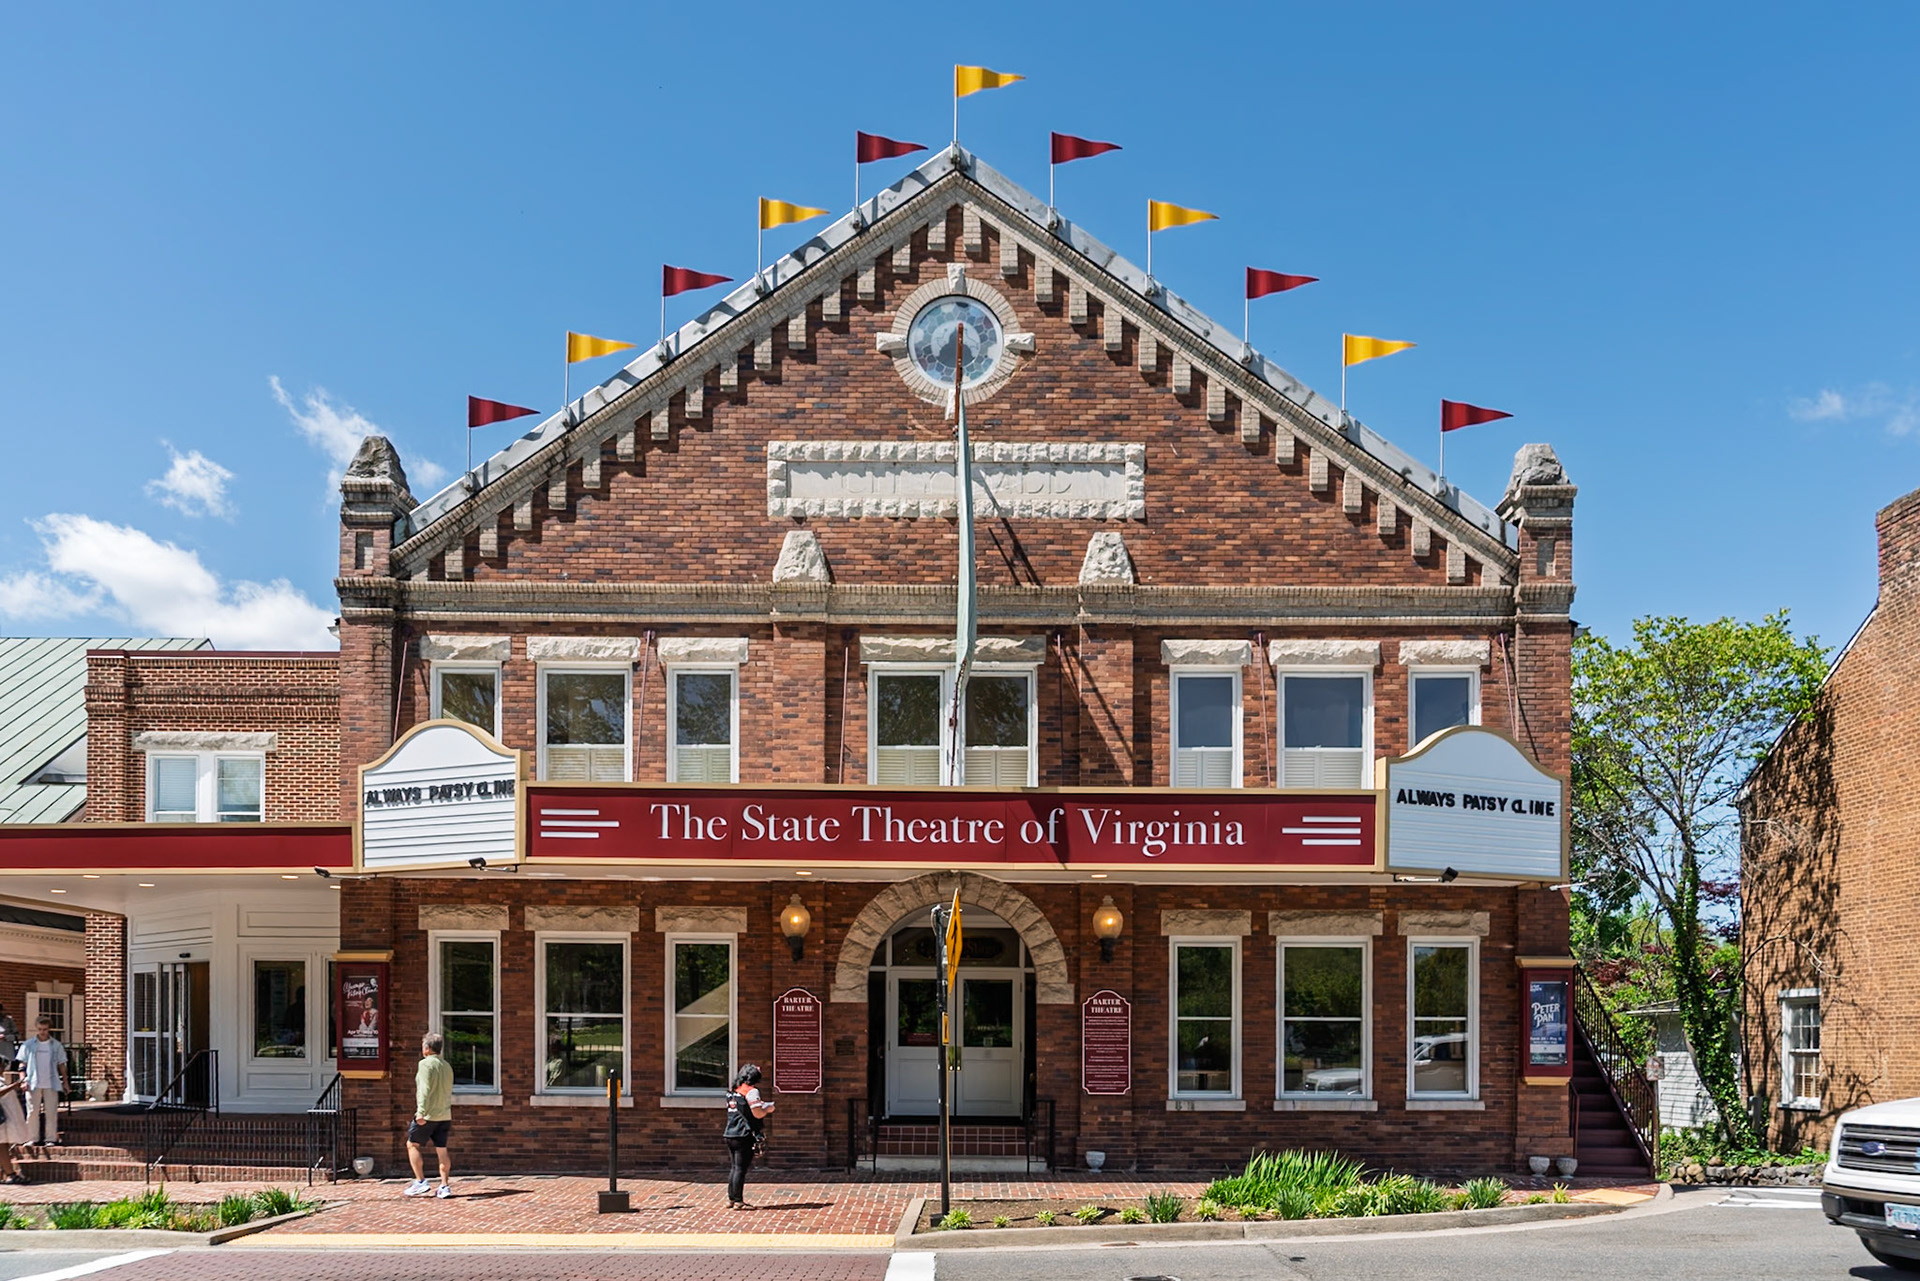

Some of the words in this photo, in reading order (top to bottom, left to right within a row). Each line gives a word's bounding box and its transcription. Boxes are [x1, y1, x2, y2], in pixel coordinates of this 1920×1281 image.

[365, 787, 422, 806] ALWAYS
[429, 782, 474, 800] PATSY
[477, 779, 515, 796] CLINE
[1396, 788, 1456, 808] ALWAYS
[1463, 794, 1508, 812] PATSY
[1511, 799, 1555, 816] CLINE
[650, 803, 728, 841] The
[741, 804, 841, 843] State
[852, 806, 1004, 844] Theatre
[1020, 807, 1065, 845] of
[1077, 808, 1247, 858] Virginia
[1531, 1002, 1560, 1016] PETER
[1533, 1012, 1555, 1028] PAN
